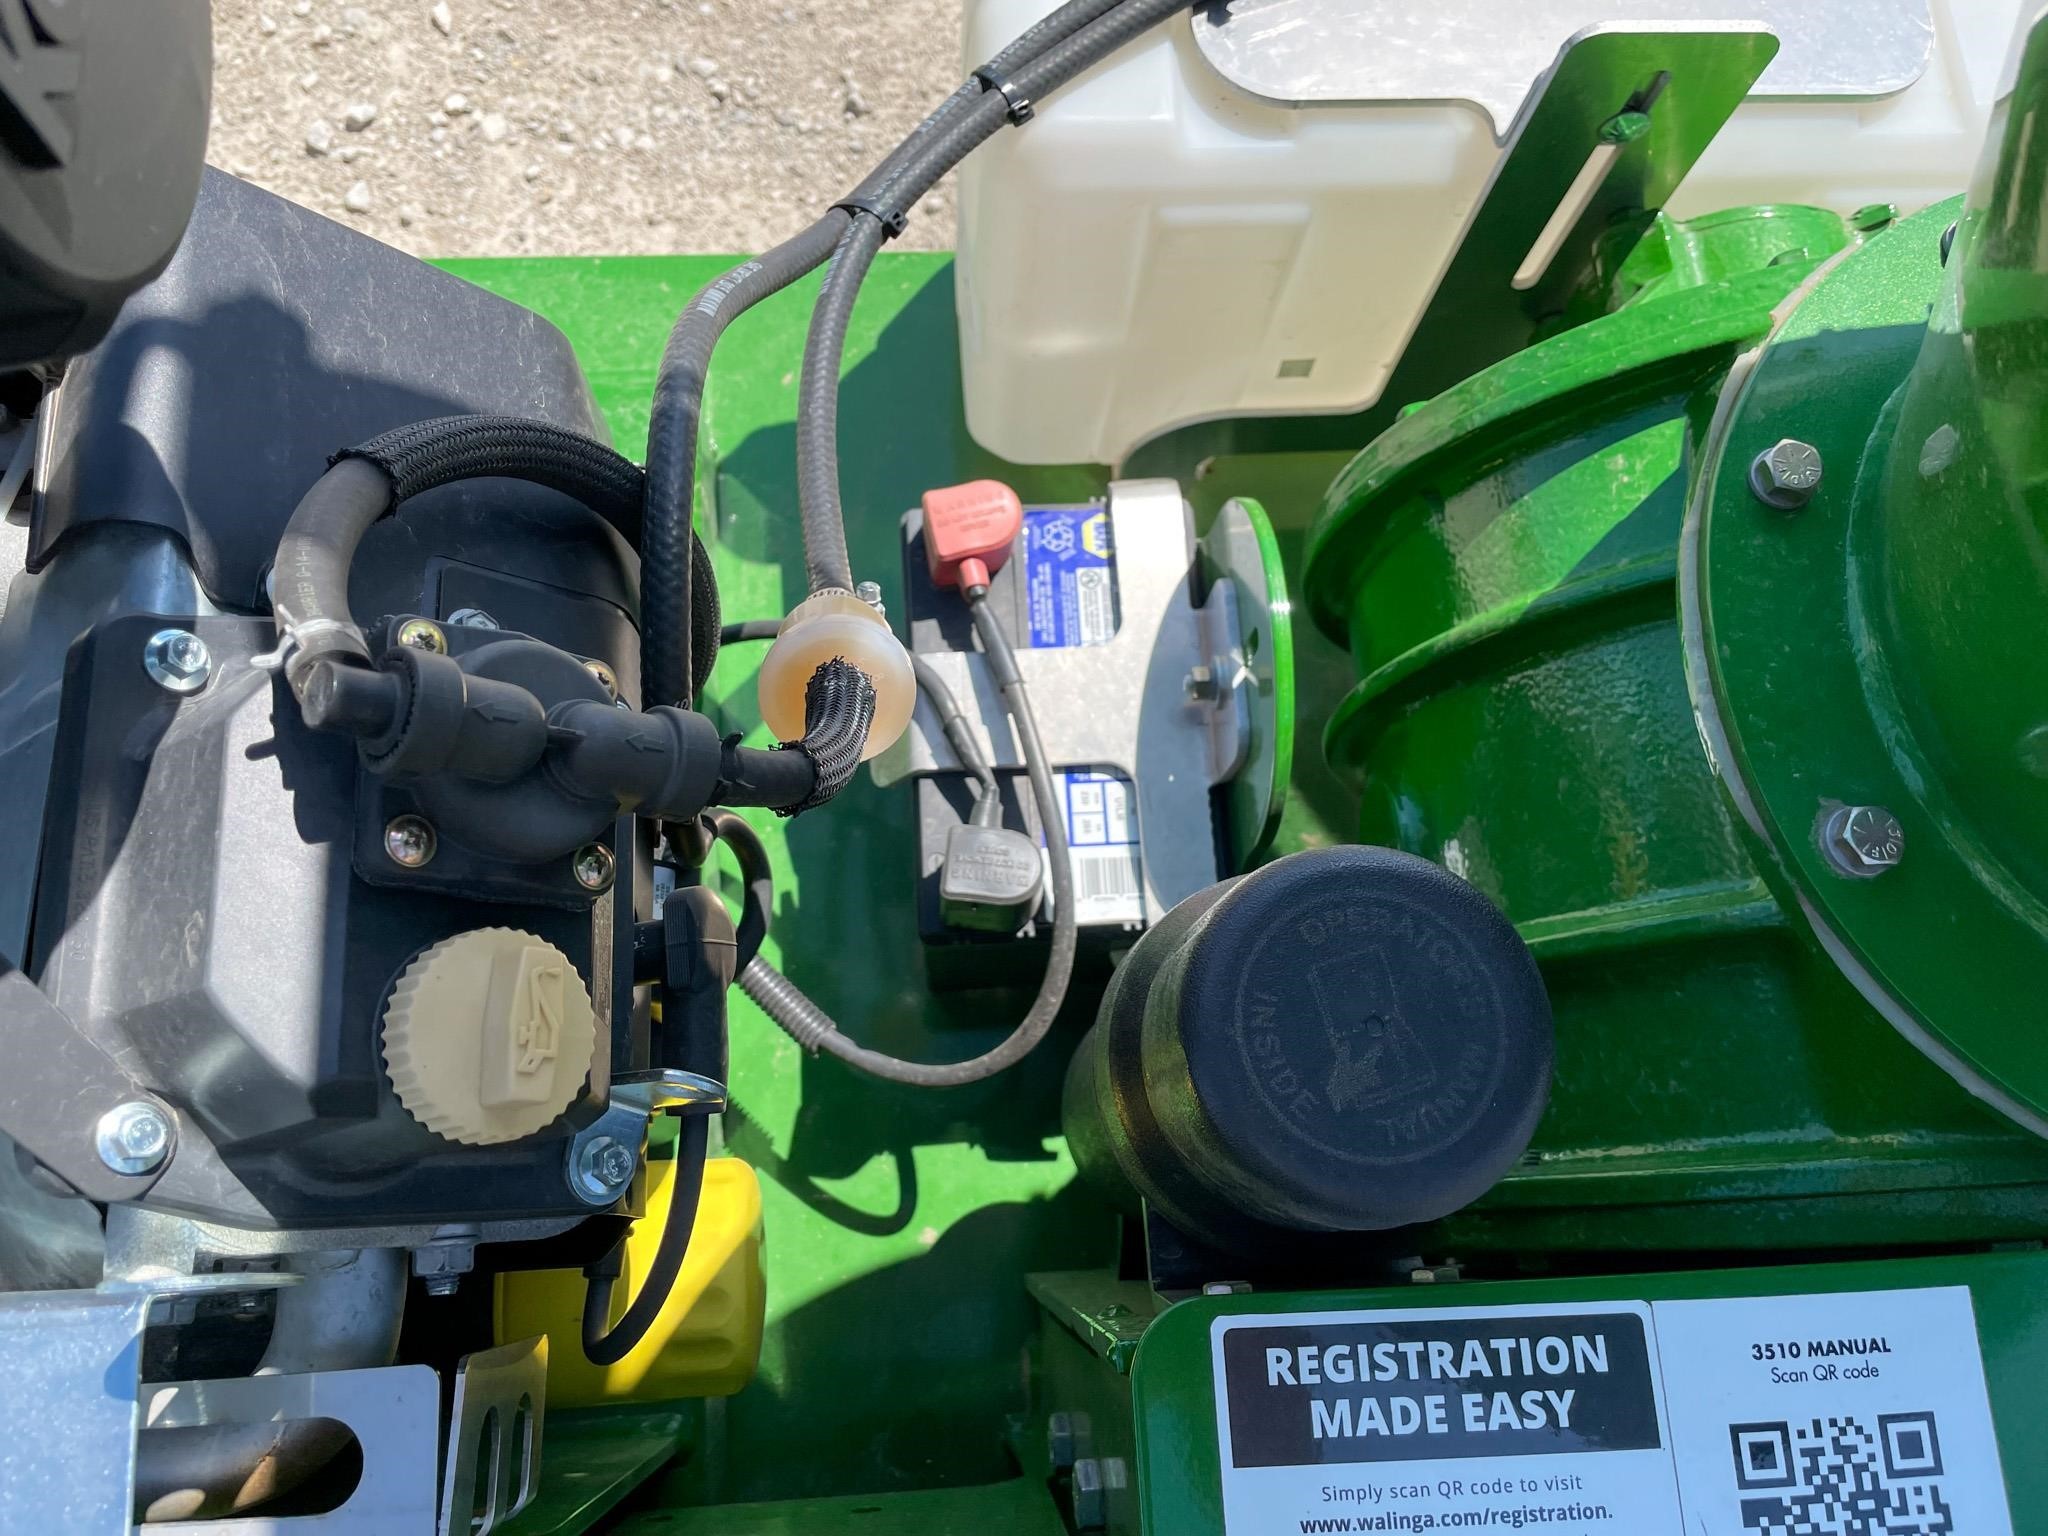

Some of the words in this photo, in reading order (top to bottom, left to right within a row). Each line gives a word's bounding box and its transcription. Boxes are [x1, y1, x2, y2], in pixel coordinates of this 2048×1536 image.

[1265, 1334, 1608, 1386] REGISTRATION
[1751, 1341, 1801, 1361] 3510
[1807, 1336, 1892, 1358] MANUAL
[1771, 1366, 1809, 1384] Scan
[1812, 1364, 1839, 1381] QR
[1843, 1359, 1880, 1380] code
[1310, 1394, 1448, 1439] MADE
[1462, 1388, 1576, 1434] EASY
[1321, 1482, 1383, 1505] Simply
[1389, 1483, 1431, 1500] scan
[1437, 1479, 1464, 1497] QR
[1470, 1476, 1513, 1496] code
[1519, 1476, 1539, 1493] to
[1543, 1473, 1583, 1492] visit
[1299, 1502, 1613, 1535] www.walinga.com/registration.
